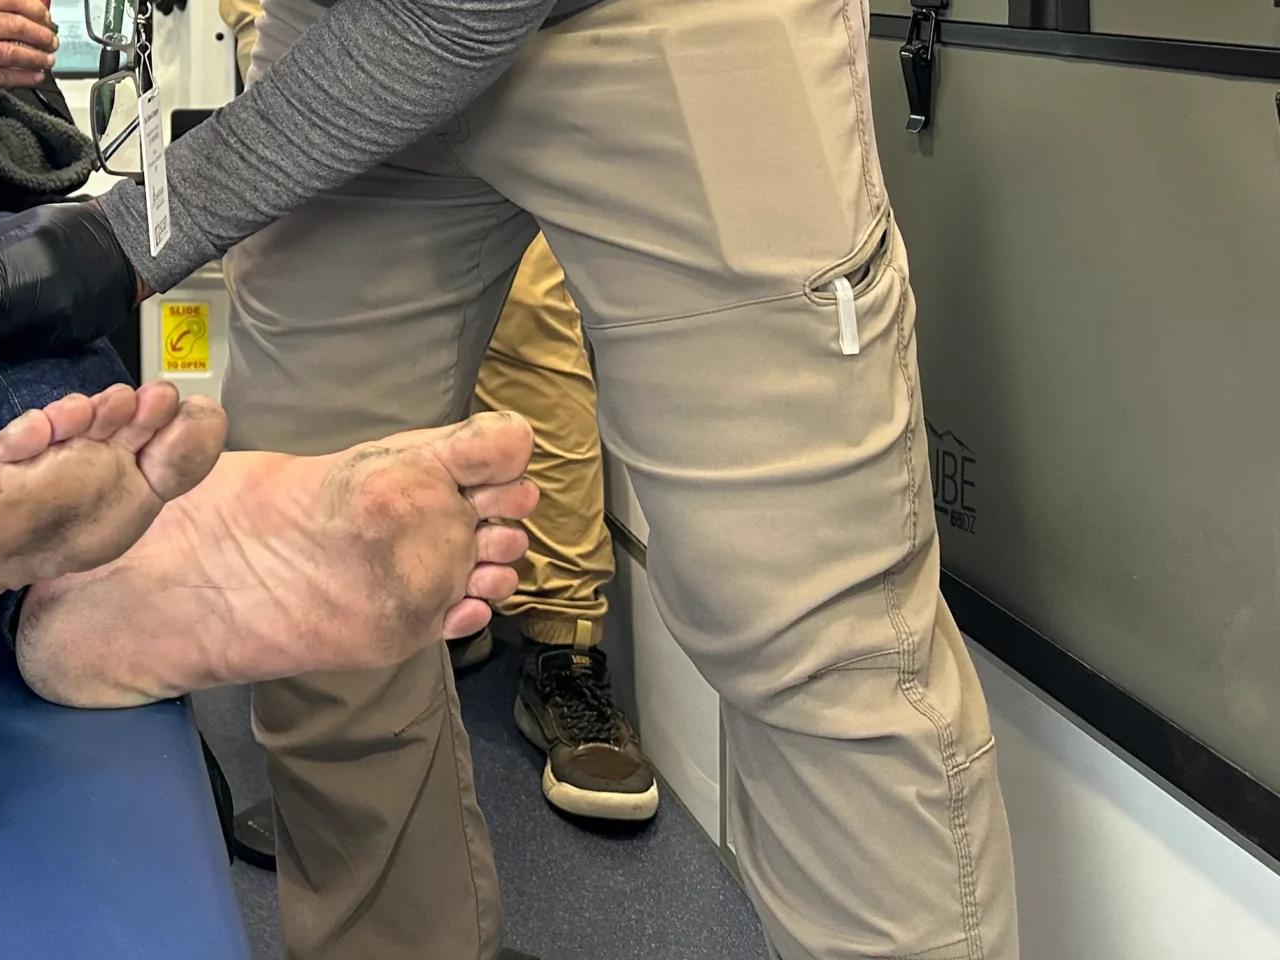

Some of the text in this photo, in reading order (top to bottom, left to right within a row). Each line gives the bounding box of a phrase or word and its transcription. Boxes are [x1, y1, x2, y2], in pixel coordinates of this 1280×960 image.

[169, 305, 201, 316] SLIDE
[167, 360, 206, 370] TO OPEN
